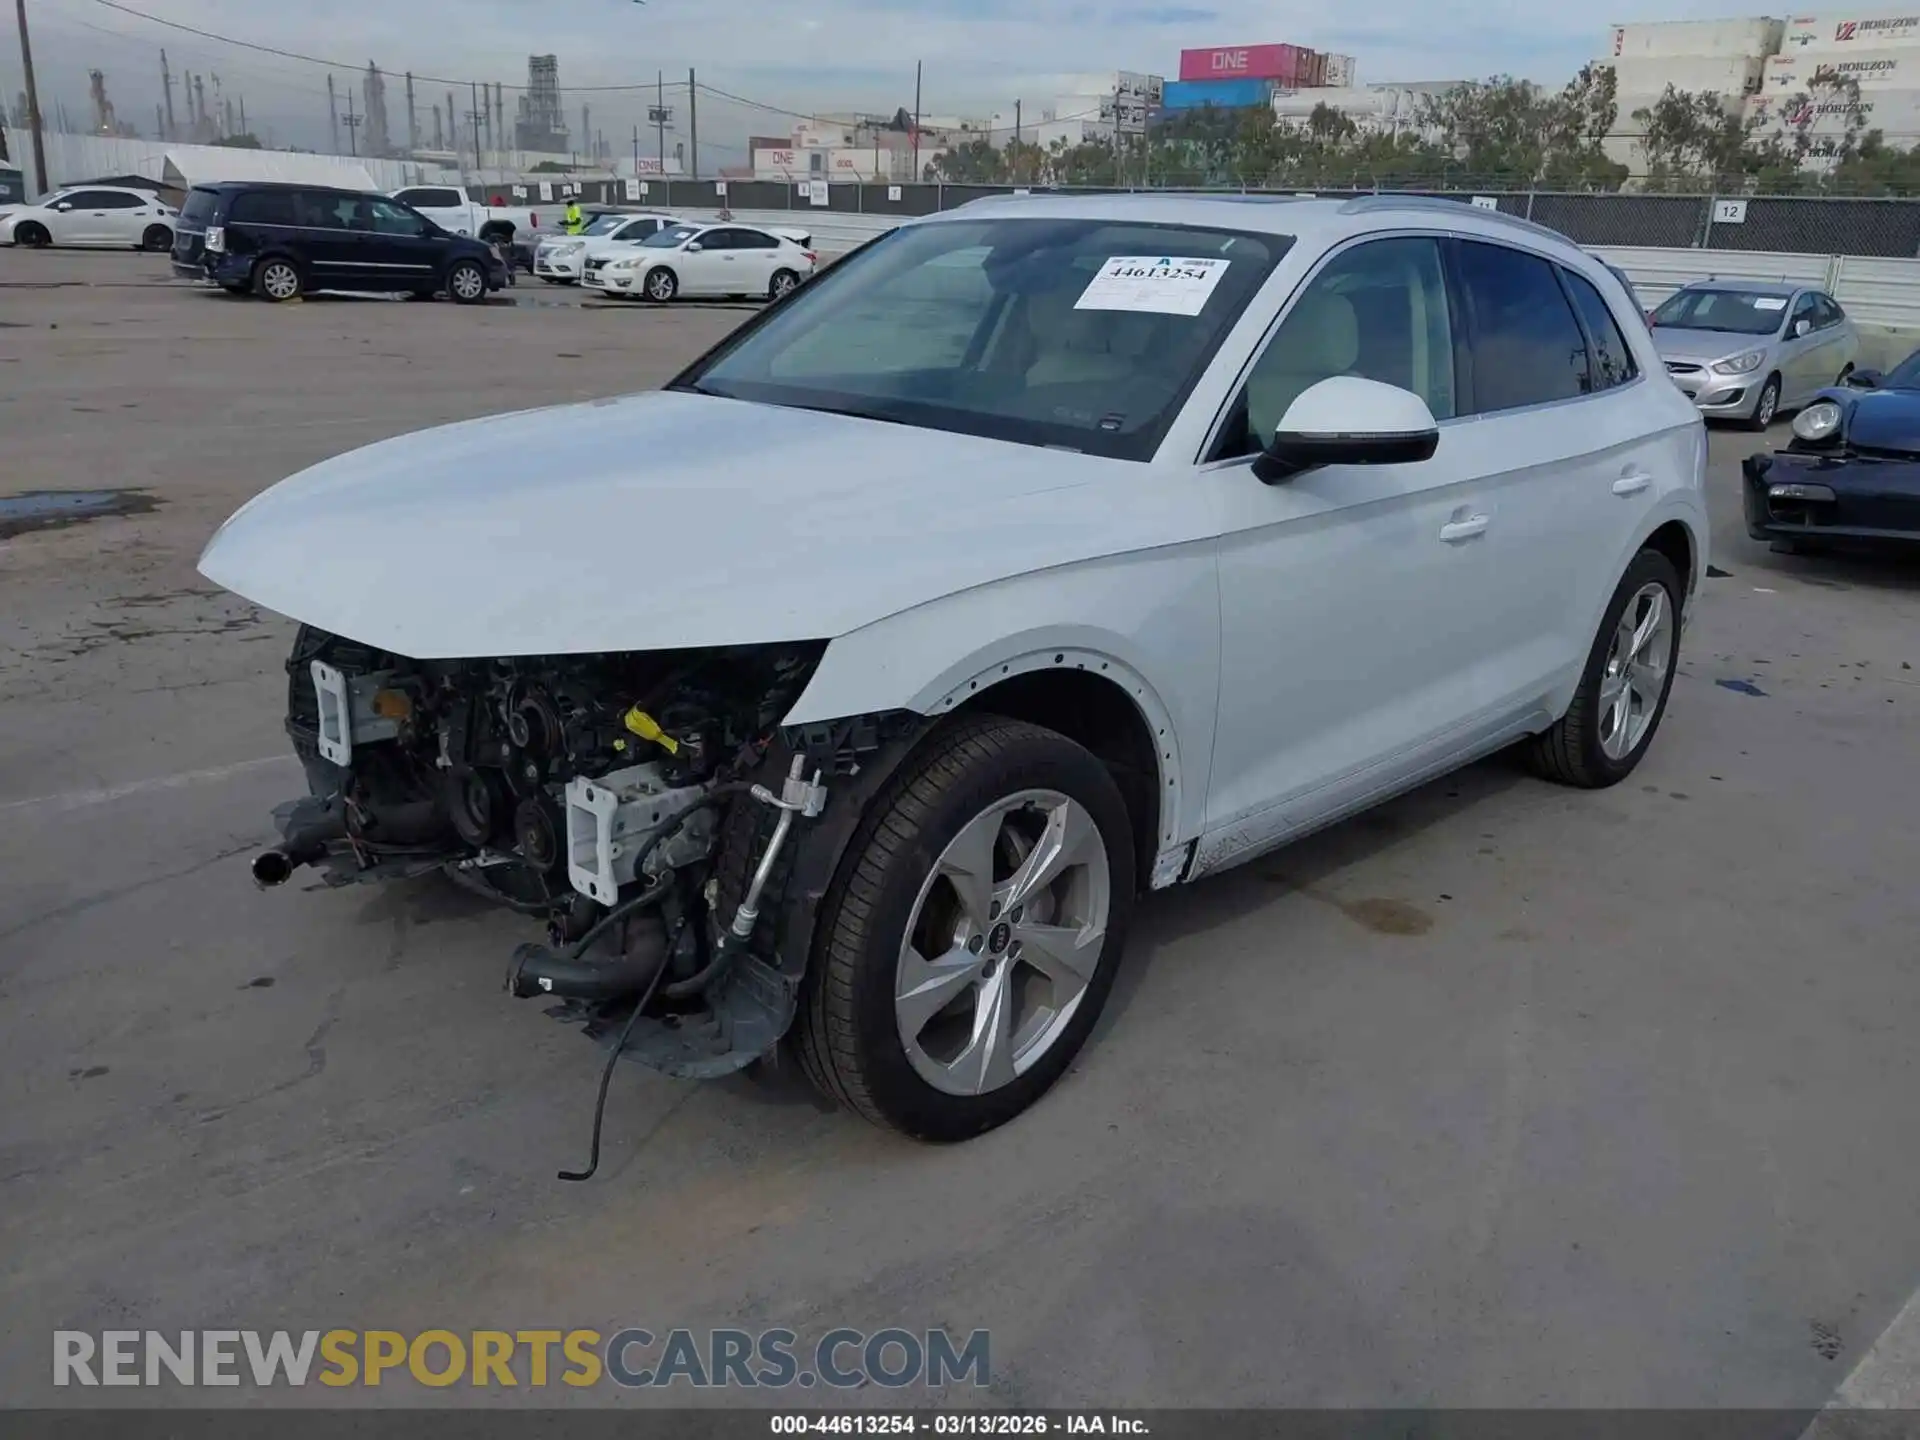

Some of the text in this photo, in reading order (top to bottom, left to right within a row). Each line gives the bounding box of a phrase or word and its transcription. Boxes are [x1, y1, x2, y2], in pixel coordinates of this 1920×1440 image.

[1211, 50, 1249, 70] ONE
[1838, 60, 1897, 72] HORIZON
[772, 152, 795, 165] ONE
[639, 160, 661, 171] ONE
[1722, 206, 1739, 218] 12
[1109, 266, 1208, 281] 44613254
